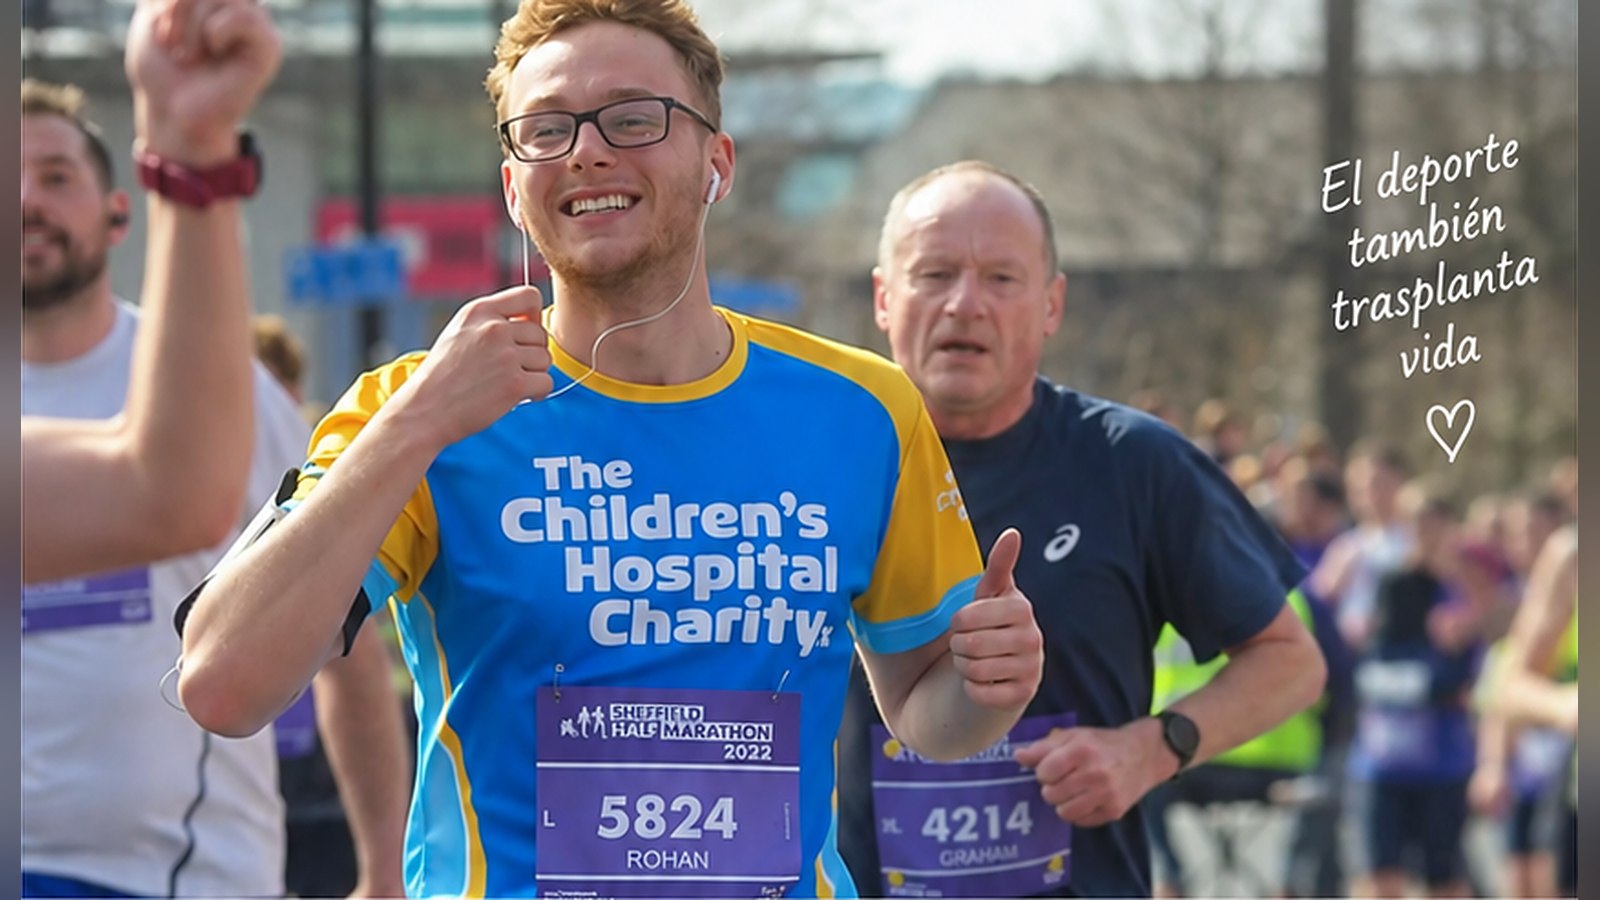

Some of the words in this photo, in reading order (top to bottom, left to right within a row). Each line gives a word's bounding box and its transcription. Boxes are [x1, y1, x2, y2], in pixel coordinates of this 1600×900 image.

[533, 455, 633, 490] The
[500, 491, 829, 543] Children’s
[565, 542, 838, 601] Hospital
[589, 595, 827, 658] Charity
[661, 723, 773, 742] MARATHON
[723, 743, 773, 760] 2022
[543, 809, 556, 827] L
[597, 794, 738, 839] 5824
[921, 801, 1034, 843] 4214
[627, 850, 709, 870] ROHAN
[939, 846, 1018, 868] GRAHAM
